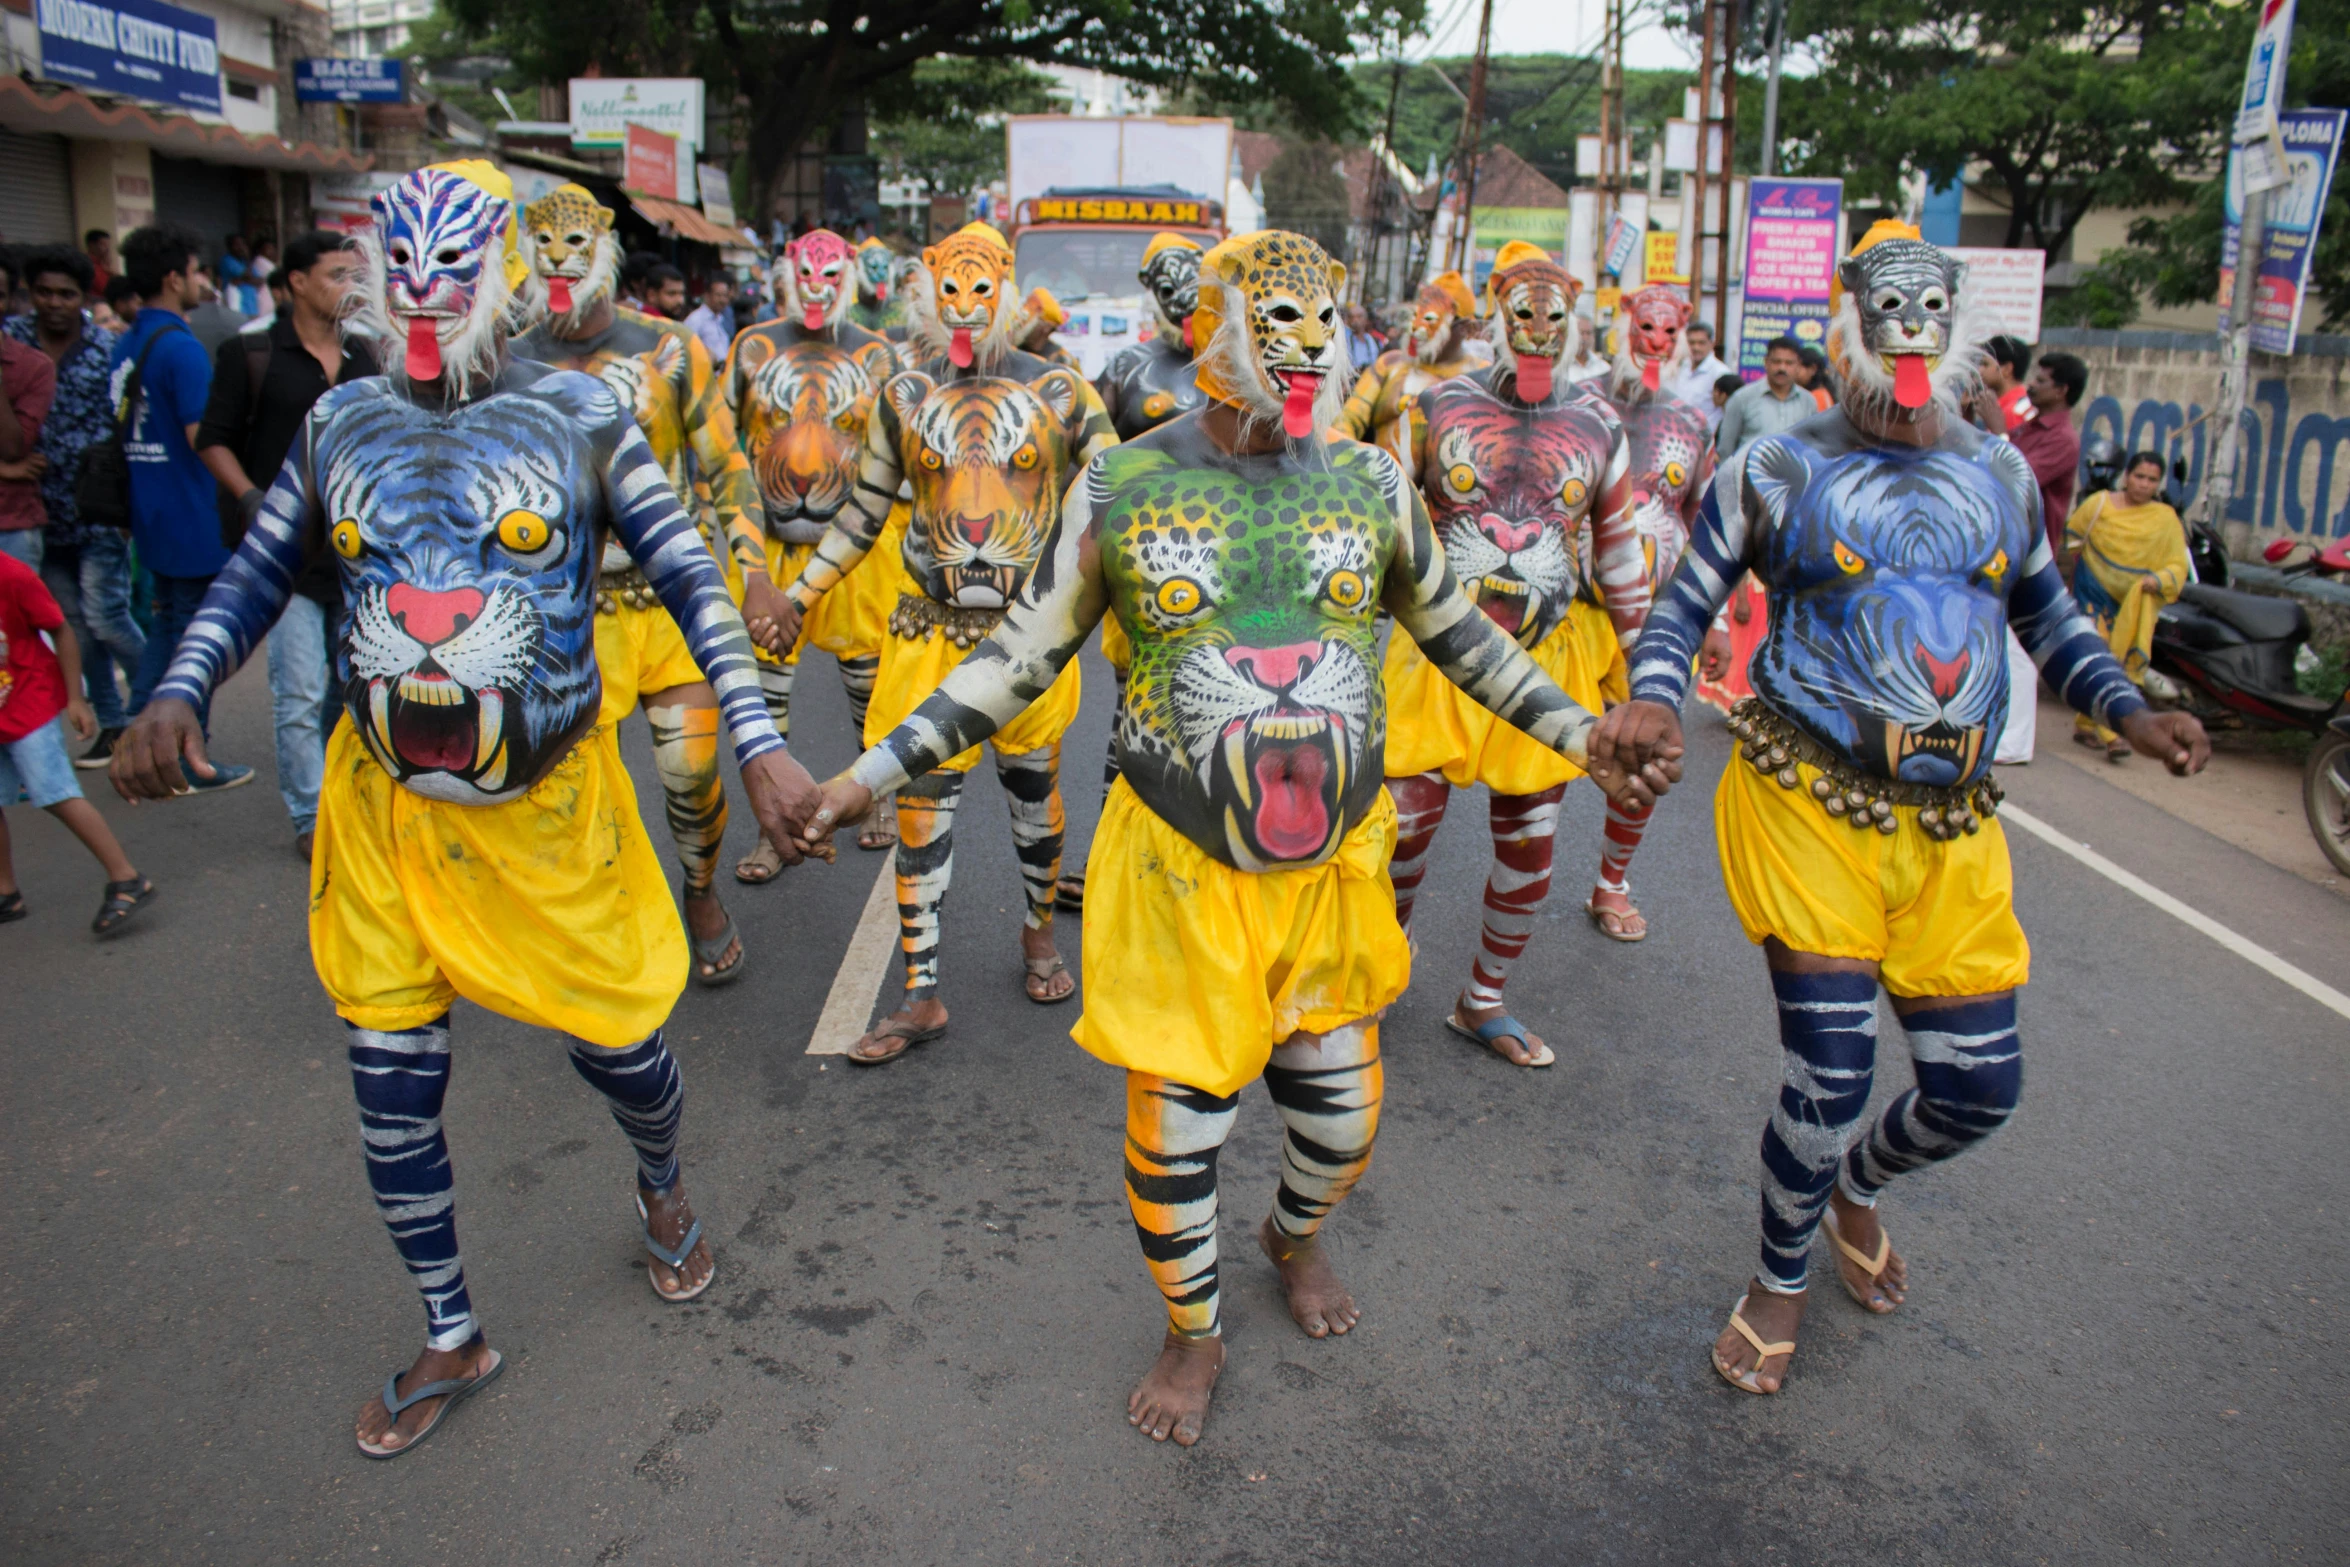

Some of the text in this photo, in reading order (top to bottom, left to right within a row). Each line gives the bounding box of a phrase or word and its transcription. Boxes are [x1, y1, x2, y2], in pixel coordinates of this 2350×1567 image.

[40, 0, 218, 76] MODERN CHITTY FUND
[1038, 201, 1199, 222] MISBAAH
[1752, 221, 1833, 237] FRESH JUICE
[1766, 236, 1817, 249] SHAKES
[1754, 249, 1828, 264] FRESH LIME
[1756, 263, 1825, 277] ICE CREAM
[1792, 278, 1803, 289] &
[1805, 278, 1829, 291] TEA
[1744, 302, 1830, 317] SPECIAL OFFER
